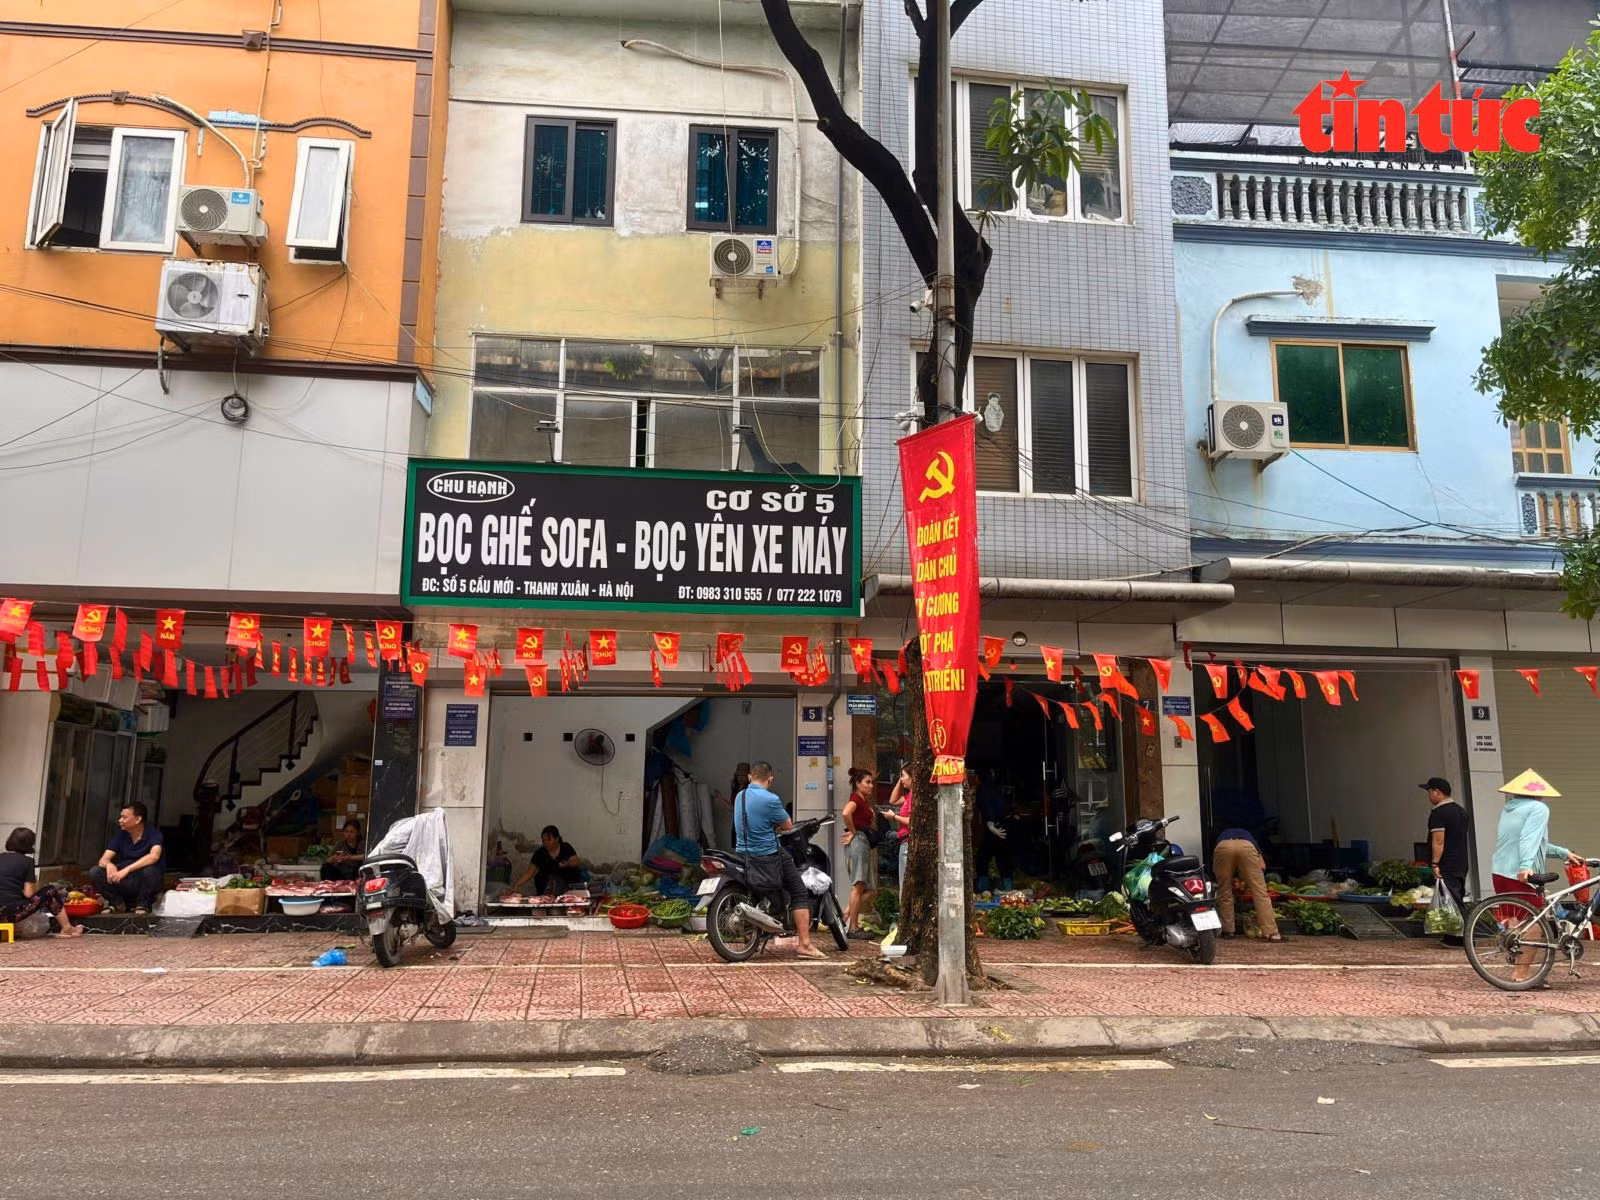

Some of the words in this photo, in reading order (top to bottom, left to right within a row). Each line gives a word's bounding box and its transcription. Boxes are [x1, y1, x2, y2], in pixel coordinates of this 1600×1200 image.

[433, 479, 464, 494] CHU
[467, 480, 508, 498] HẠNH
[706, 489, 752, 511] CƠ
[761, 484, 807, 513] SỞ
[815, 494, 835, 514] 5
[943, 511, 960, 540] KẾT
[418, 512, 472, 576] BỌC
[481, 498, 536, 567] GHẾ
[541, 517, 607, 569] SOFA
[617, 542, 626, 554] -
[635, 521, 687, 582] BỌC
[695, 513, 743, 573] YÊN
[751, 525, 783, 574] XE
[792, 516, 847, 575] MÁY
[938, 547, 957, 578] CHỦ
[422, 577, 440, 592] ĐC:
[442, 574, 458, 592] SỐ
[460, 579, 467, 593] 5
[493, 577, 514, 594] MỚI
[524, 580, 558, 596] THANH
[561, 579, 589, 597] XUÂN
[599, 581, 613, 597] HÀ
[616, 581, 634, 600] NỘI
[678, 586, 694, 599] ĐT:
[696, 586, 721, 600] 0983
[723, 587, 741, 600] 310
[744, 588, 762, 601] 555
[767, 588, 772, 601] /
[777, 588, 795, 602] 077
[797, 589, 815, 602] 222
[818, 589, 842, 603] 1079
[934, 626, 954, 654] PHÁ
[808, 709, 816, 720] 5
[1143, 701, 1150, 710] 7
[1477, 708, 1485, 719] 9
